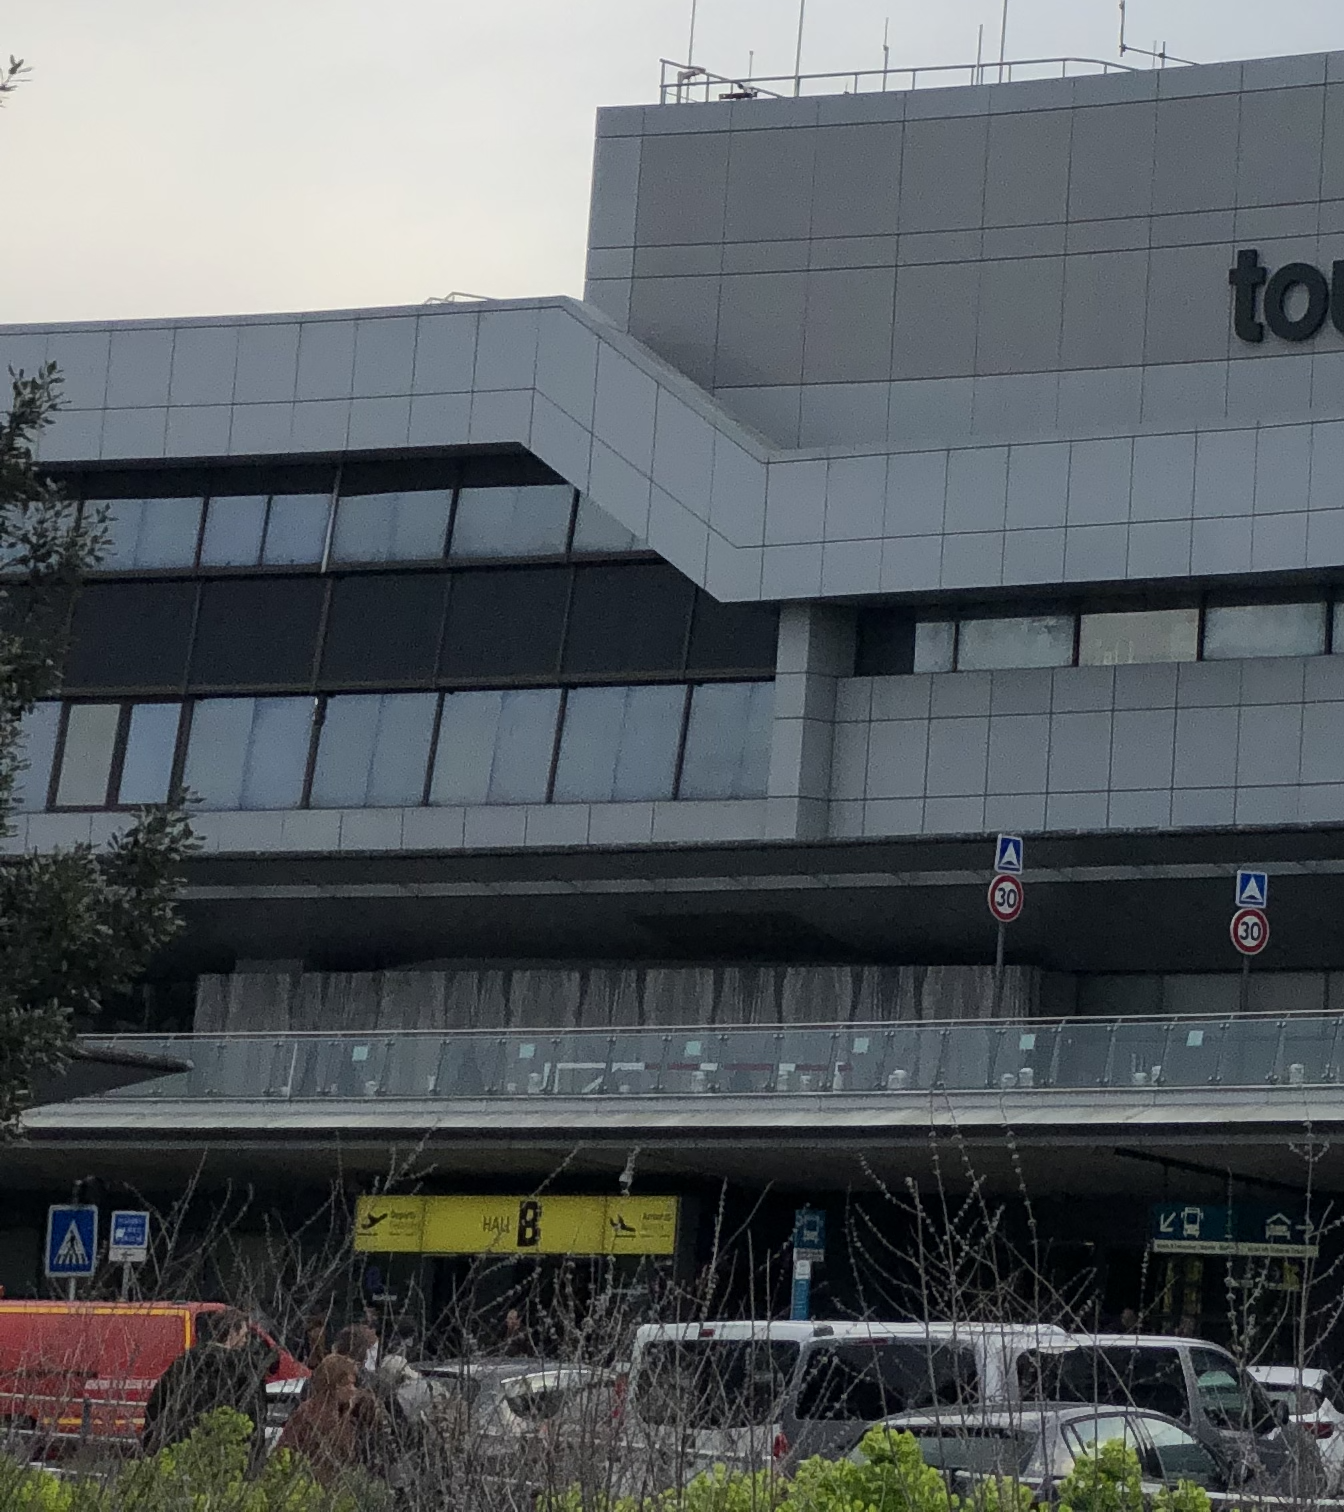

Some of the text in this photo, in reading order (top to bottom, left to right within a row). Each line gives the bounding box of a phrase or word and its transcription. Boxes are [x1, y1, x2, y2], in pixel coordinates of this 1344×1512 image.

[996, 887, 1017, 909] 30
[1238, 920, 1261, 942] 30
[482, 1200, 543, 1247] HALL B
